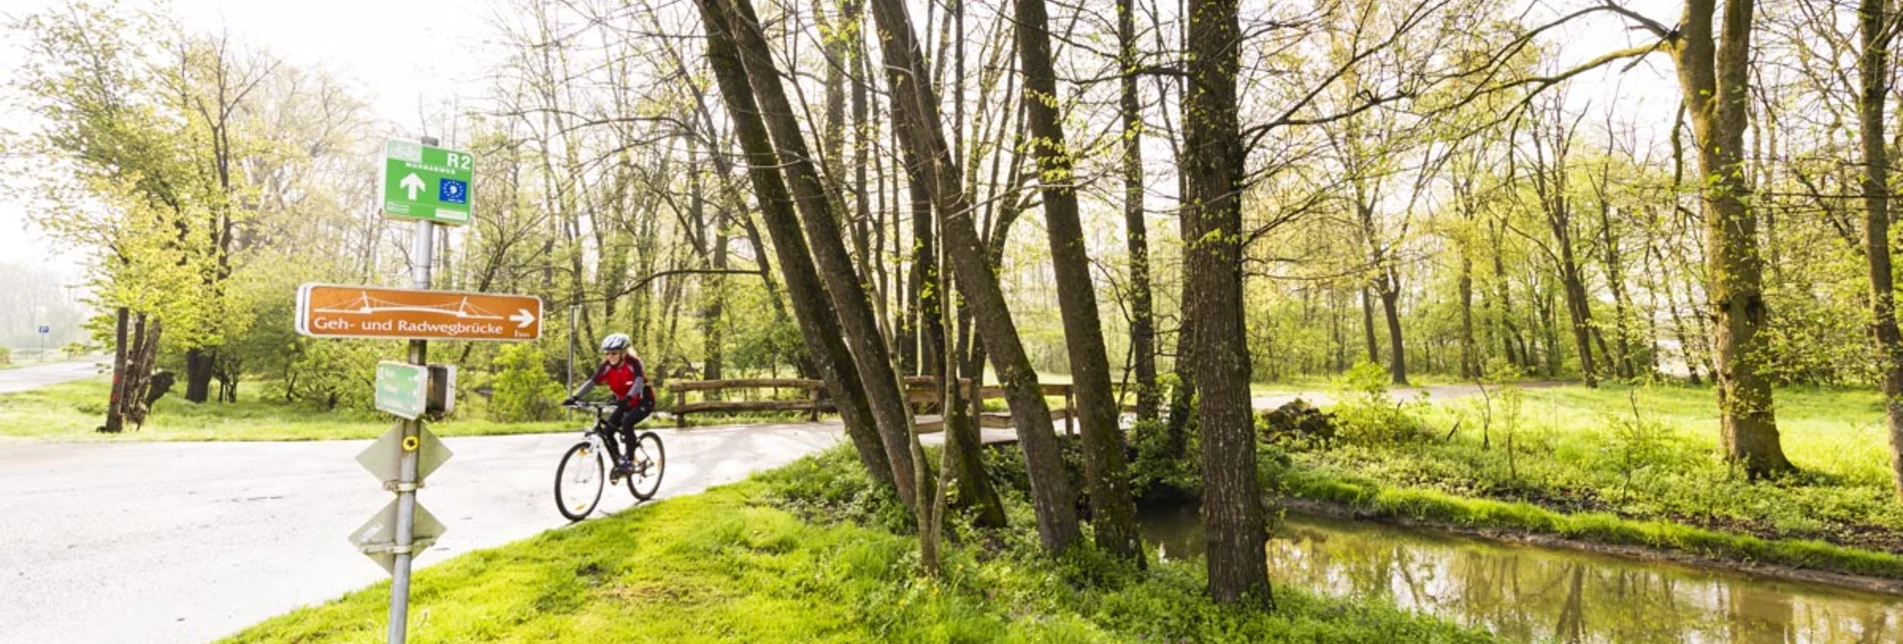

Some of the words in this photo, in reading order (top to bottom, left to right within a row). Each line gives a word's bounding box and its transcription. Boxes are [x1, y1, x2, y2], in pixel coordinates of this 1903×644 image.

[313, 317, 355, 330] Geh-
[361, 320, 392, 331] und
[398, 320, 504, 336] Radwegbrücke
